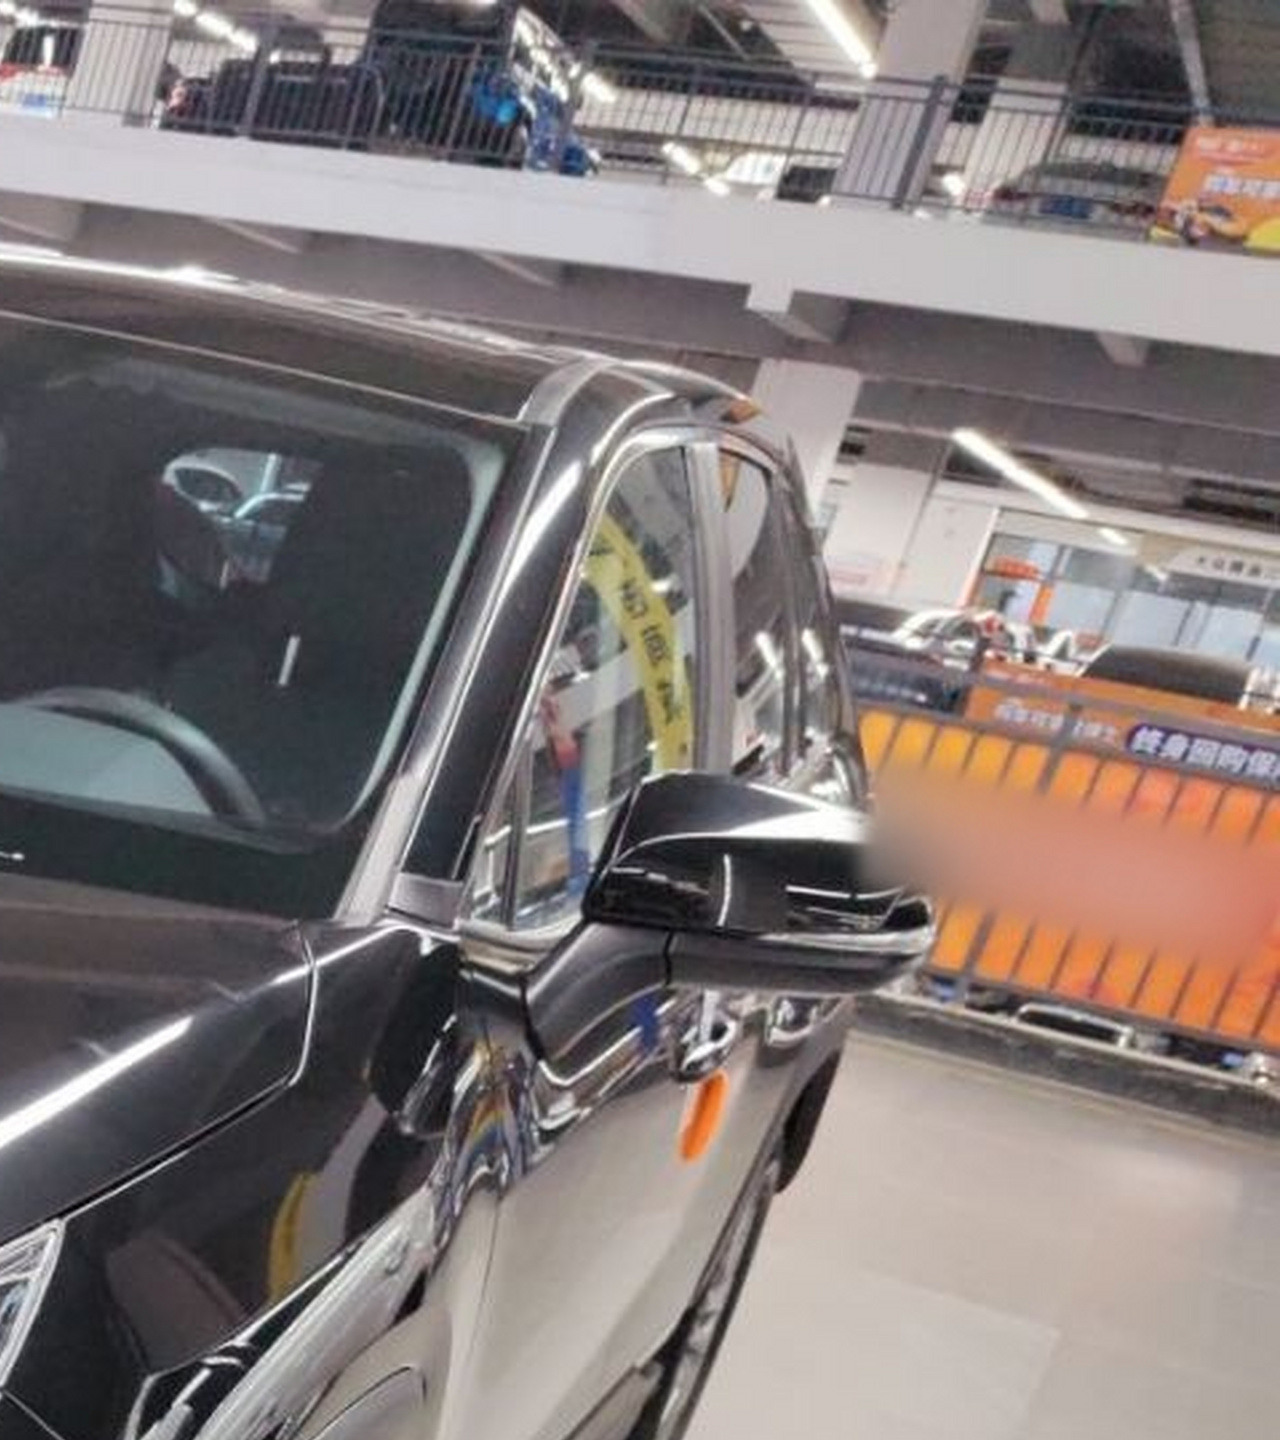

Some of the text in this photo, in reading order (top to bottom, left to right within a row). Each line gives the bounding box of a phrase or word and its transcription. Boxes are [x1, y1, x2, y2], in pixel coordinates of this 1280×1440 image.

[1130, 726, 1280, 780] 终身回购保
